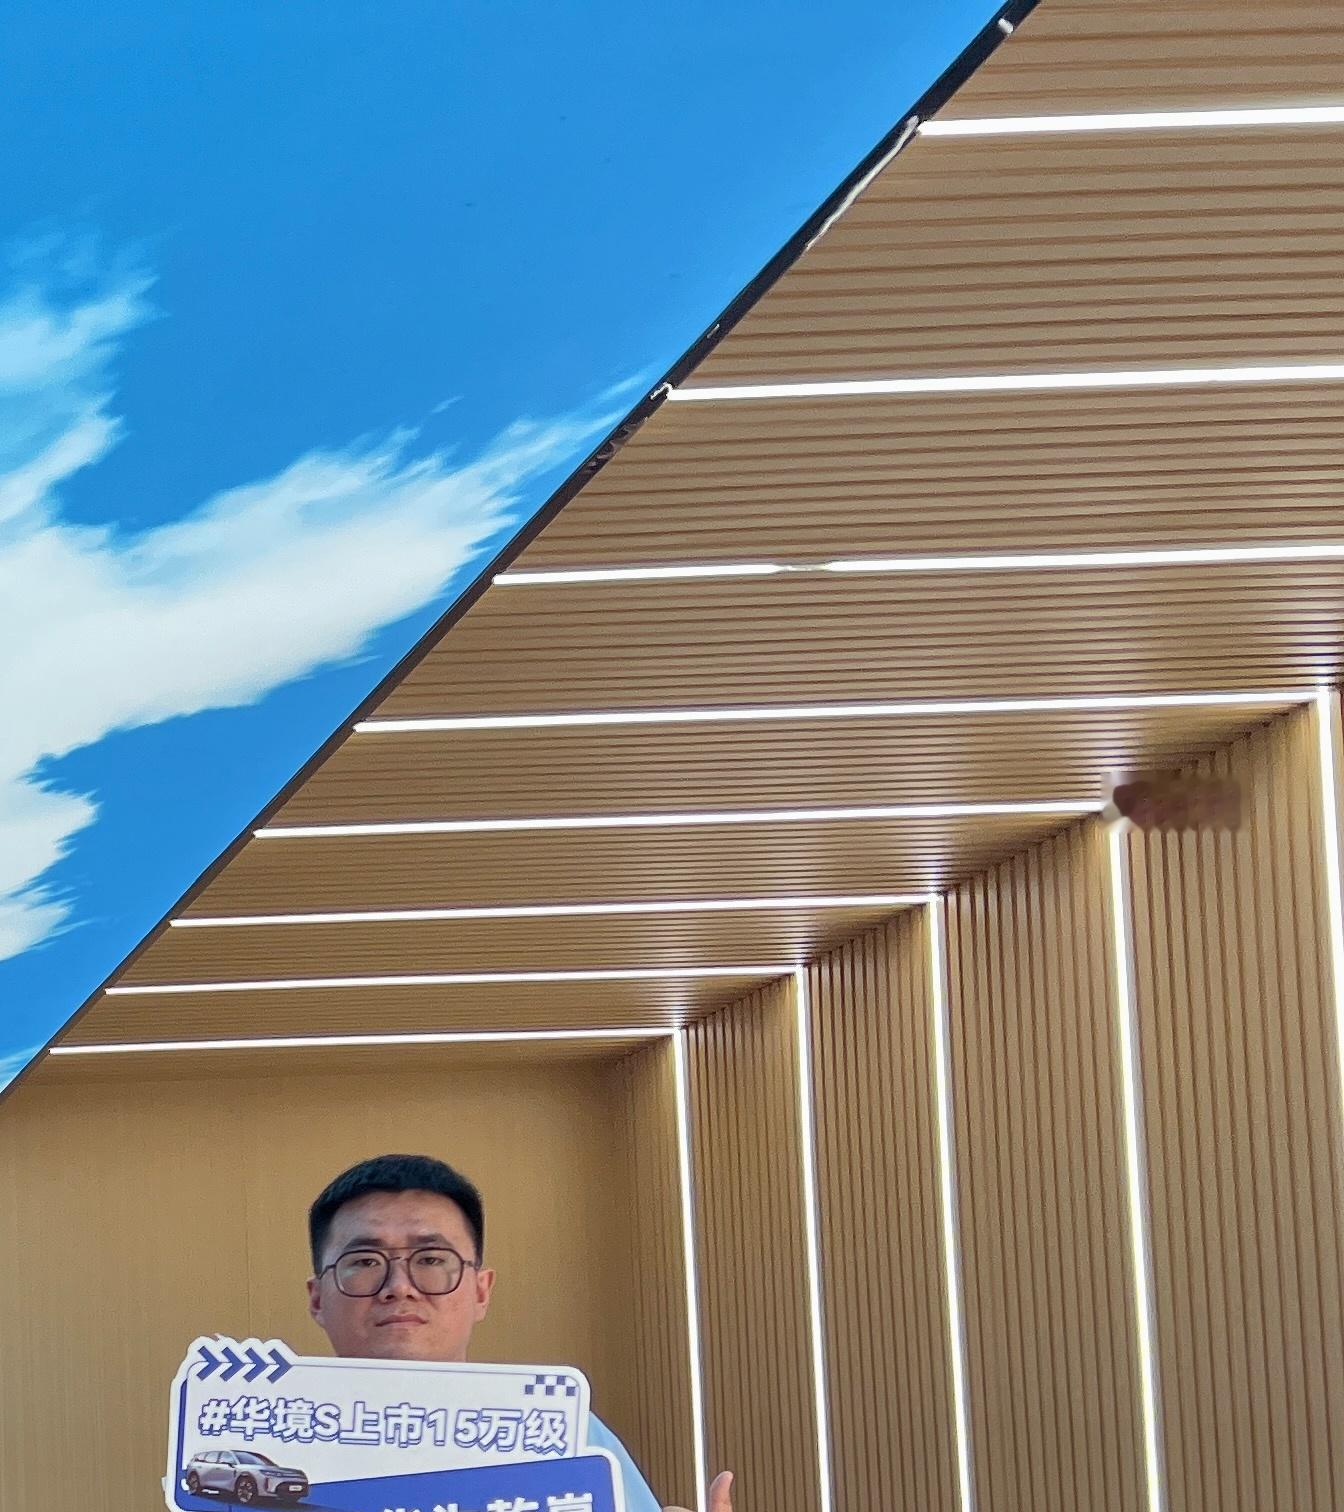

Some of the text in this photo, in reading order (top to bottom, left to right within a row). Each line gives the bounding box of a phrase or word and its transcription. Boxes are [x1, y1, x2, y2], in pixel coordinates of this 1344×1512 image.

[198, 1396, 568, 1456] #华境S上市15万级
